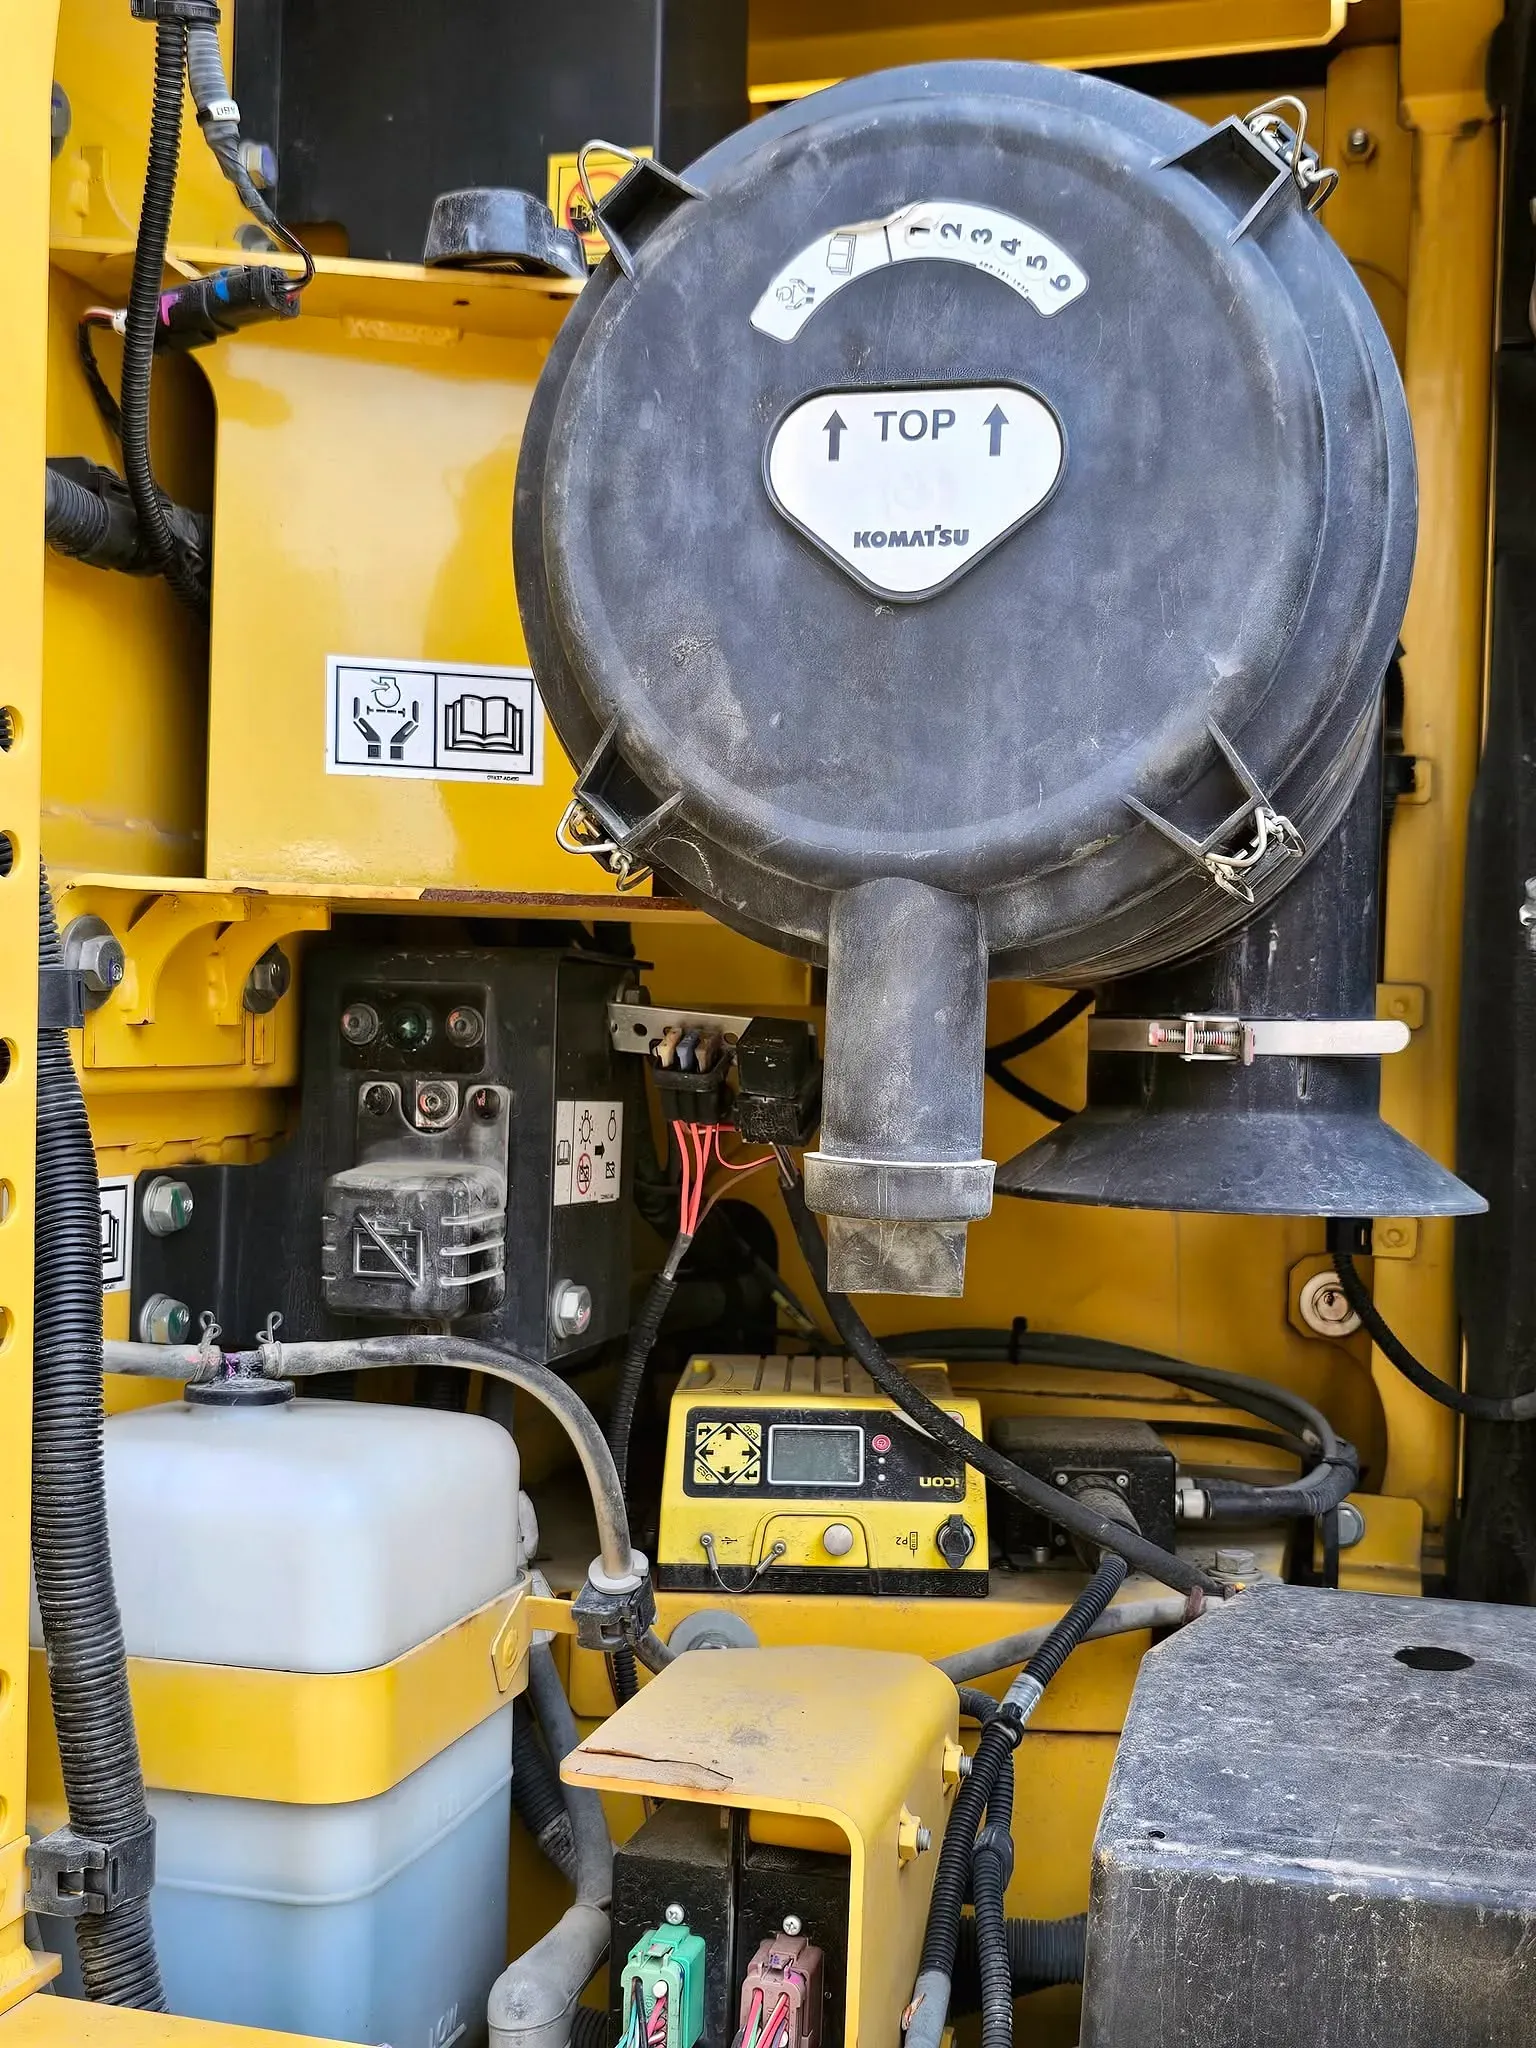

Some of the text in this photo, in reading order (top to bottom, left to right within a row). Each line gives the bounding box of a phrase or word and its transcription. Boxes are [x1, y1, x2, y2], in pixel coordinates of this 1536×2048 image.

[909, 226, 931, 236] 1
[940, 223, 962, 240] 2
[970, 228, 993, 245] 3
[1000, 238, 1021, 256] 4
[1026, 255, 1048, 271] 5
[1050, 274, 1071, 292] 6
[873, 409, 956, 442] TOP
[853, 525, 970, 549] KOMATSU
[742, 1424, 760, 1441] ESC
[696, 1465, 713, 1481] ESC
[919, 1476, 960, 1488] icon
[895, 1536, 908, 1546] P2
